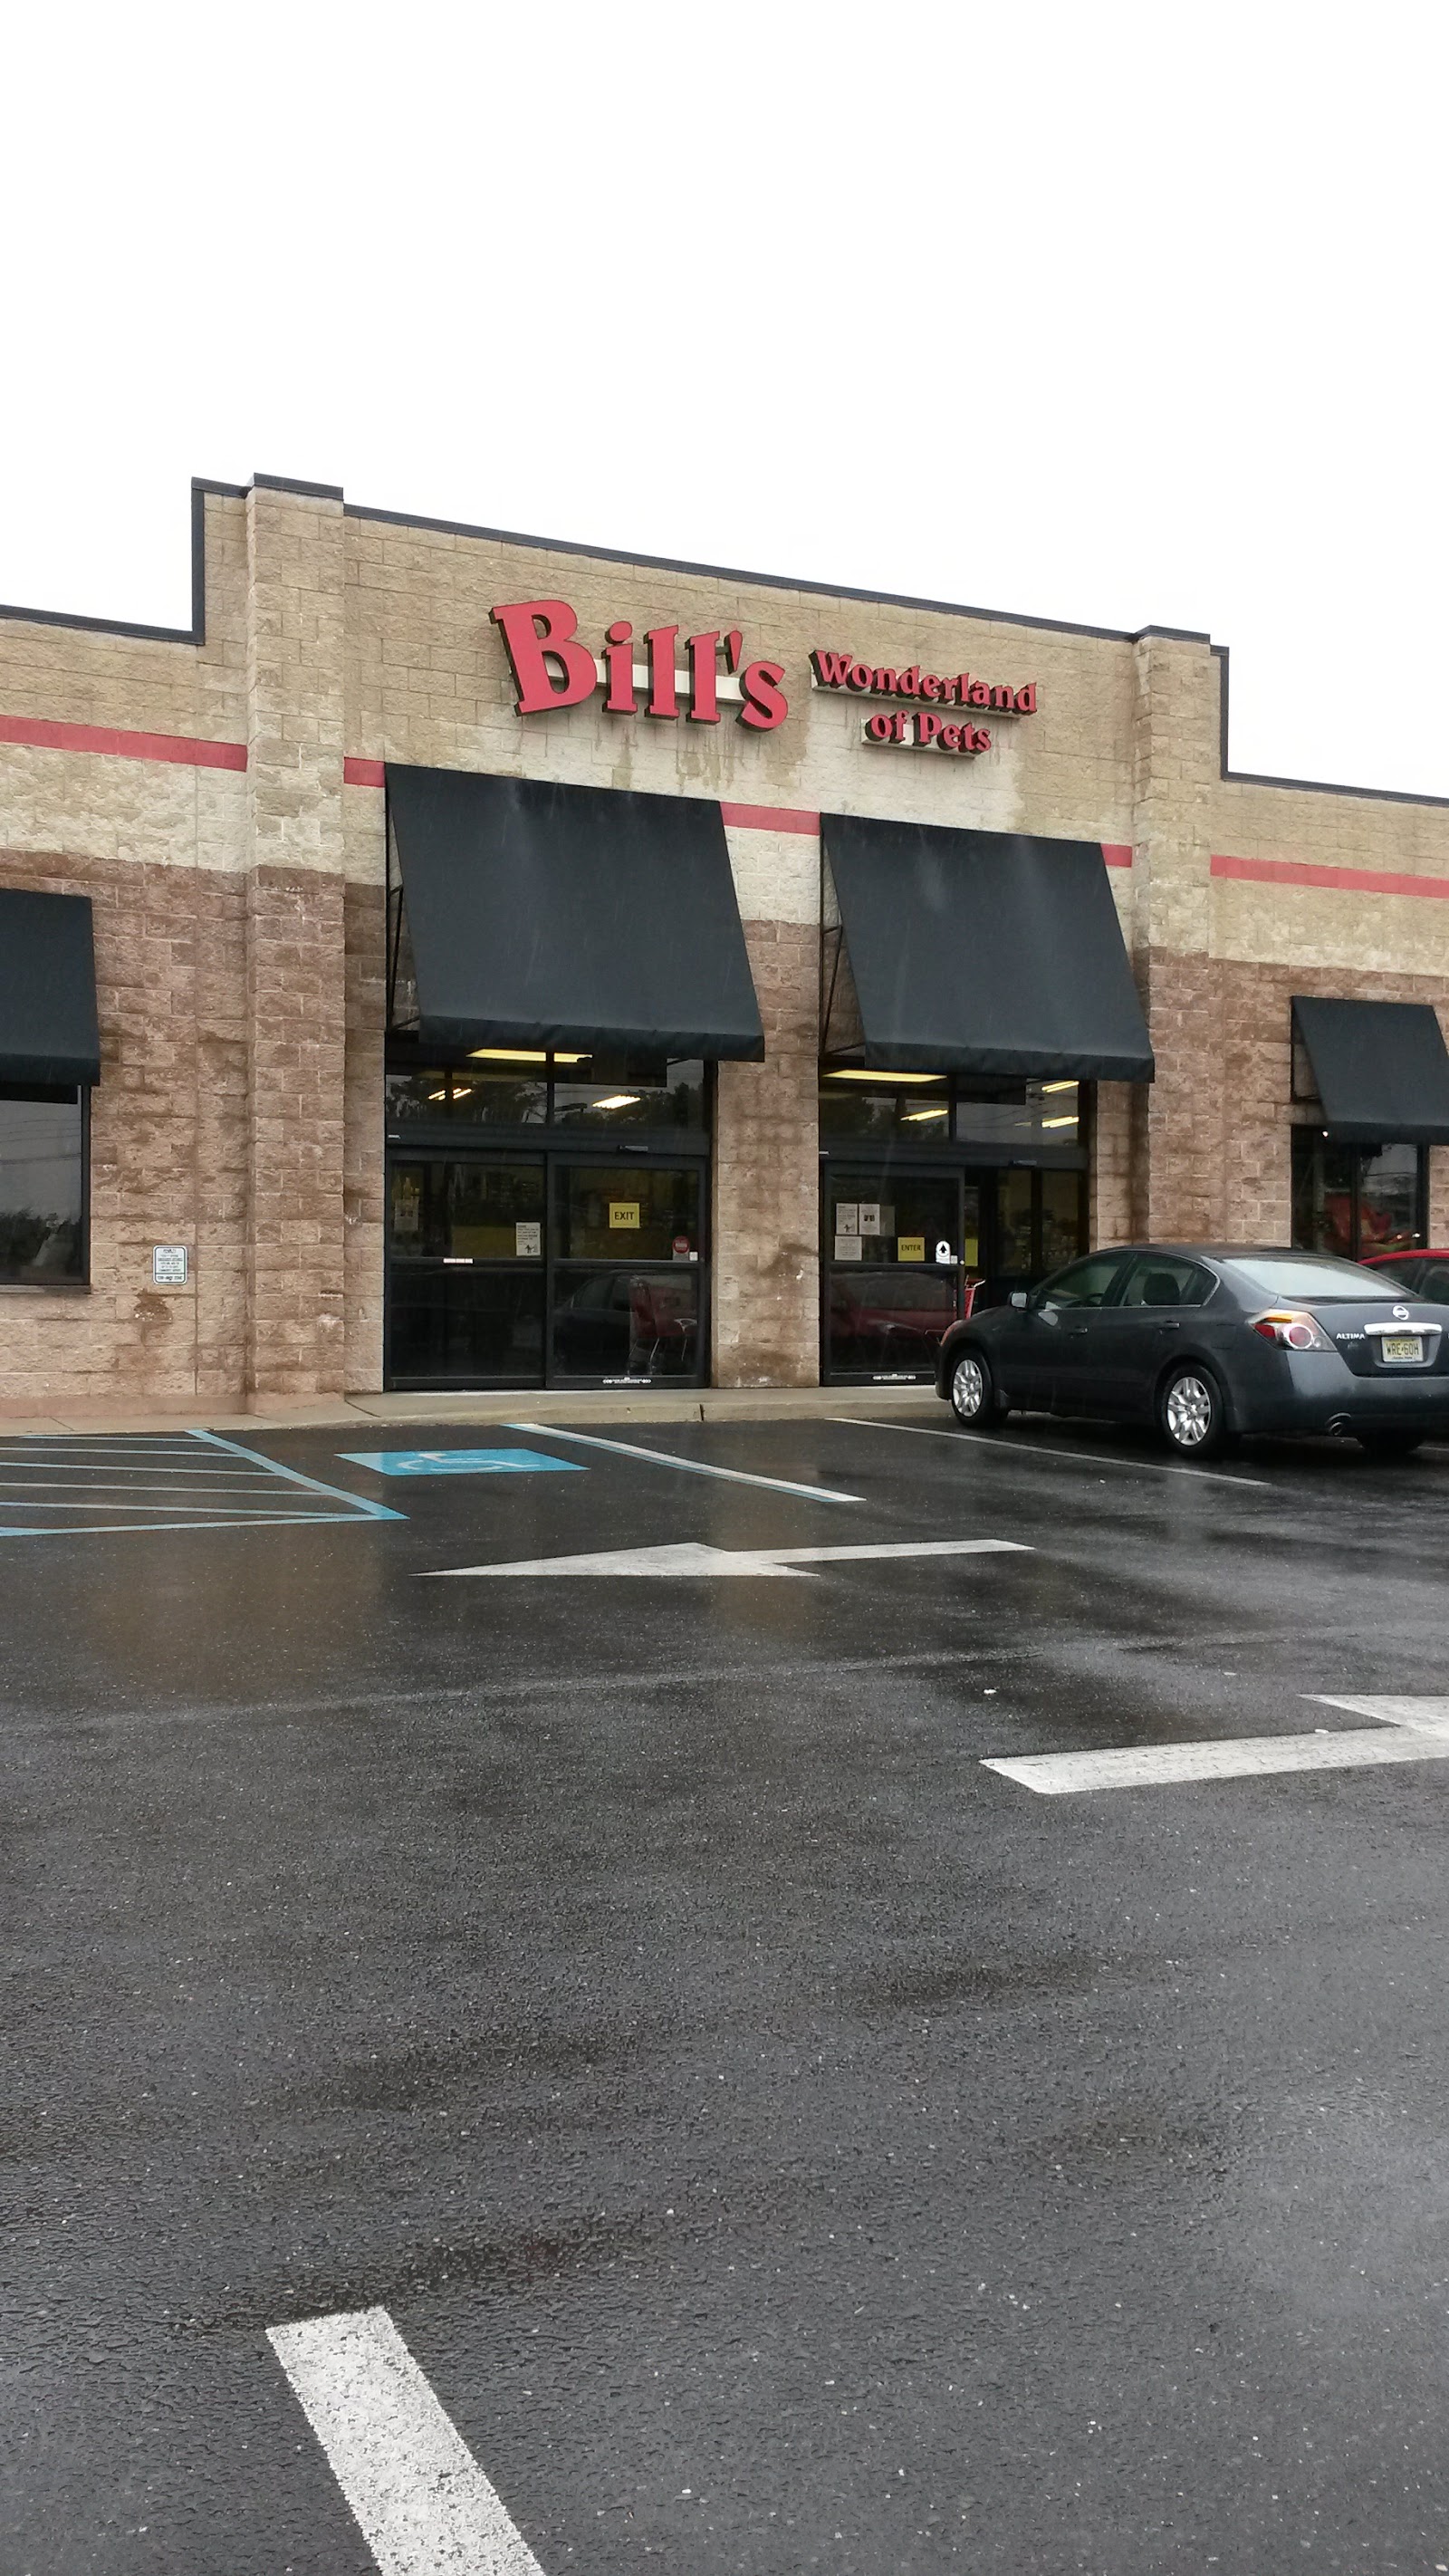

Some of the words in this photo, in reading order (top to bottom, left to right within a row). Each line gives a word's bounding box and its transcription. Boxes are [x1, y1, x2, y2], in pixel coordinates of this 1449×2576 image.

[489, 599, 789, 732] Bill's
[811, 649, 1038, 716] Wonderland
[867, 710, 909, 744] of
[913, 711, 992, 755] Pets
[614, 1211, 635, 1221] EXIT
[901, 1244, 922, 1252] ENTER
